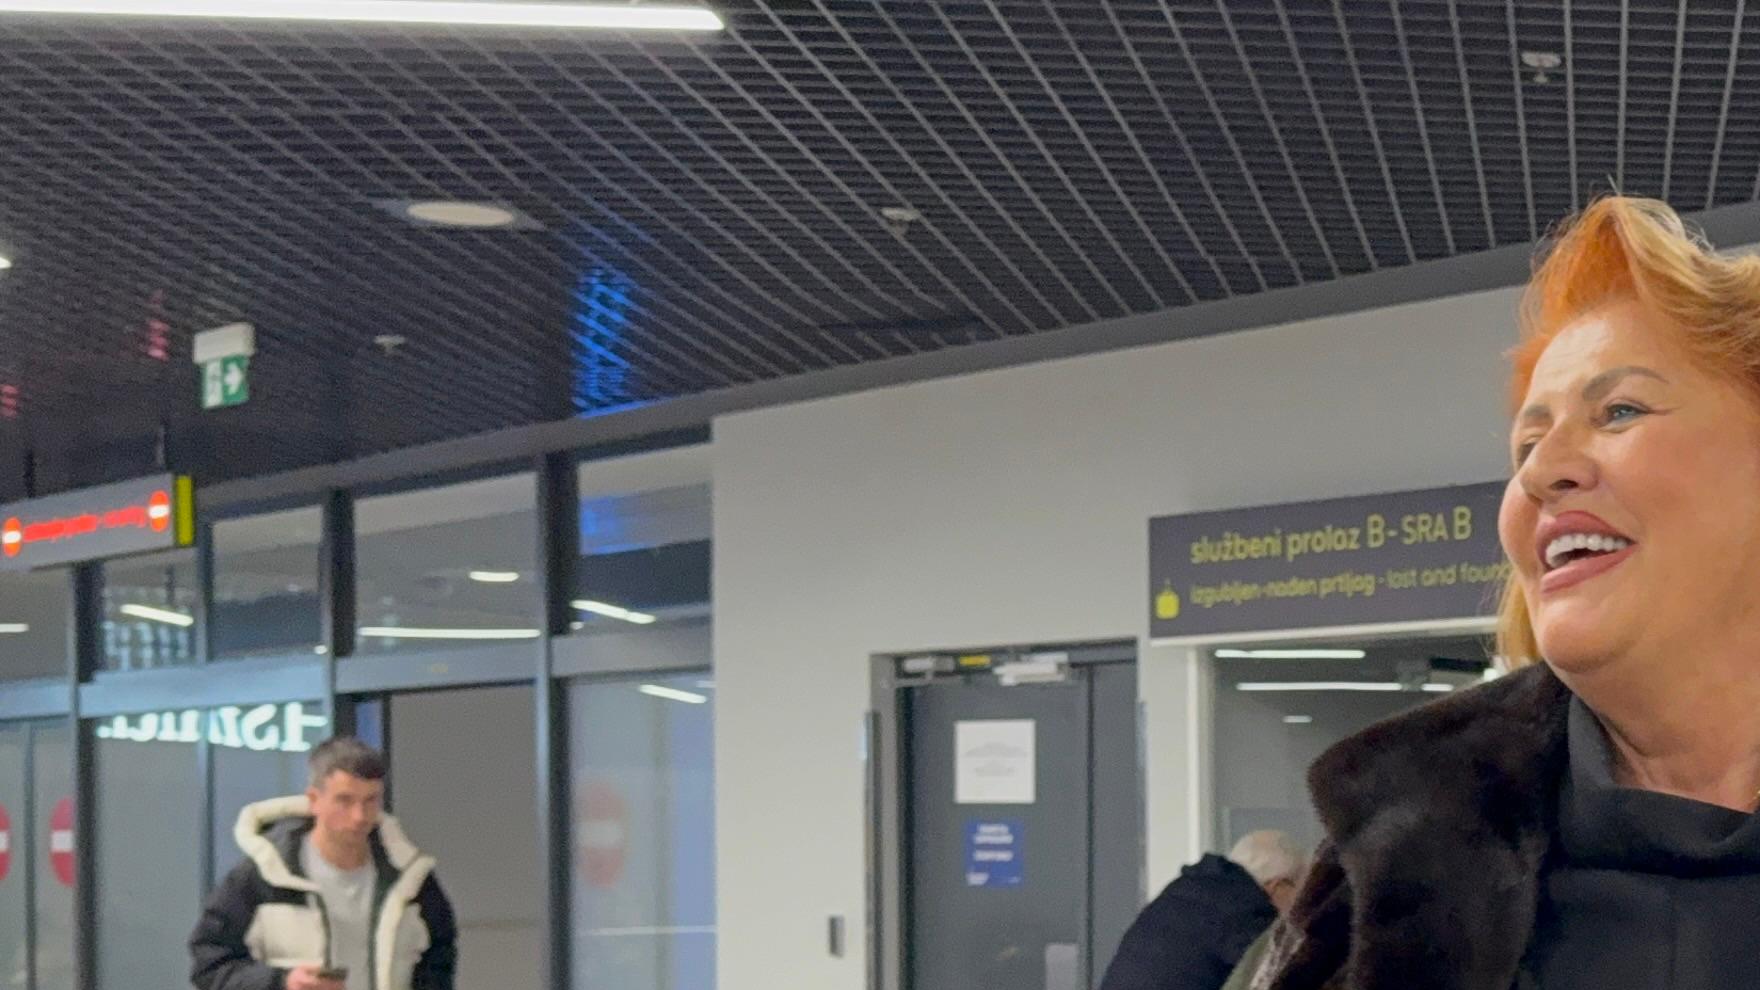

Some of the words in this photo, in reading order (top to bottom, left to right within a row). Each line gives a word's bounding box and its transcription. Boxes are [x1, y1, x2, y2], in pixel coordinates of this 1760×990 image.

[1191, 528, 1282, 564] službeni
[1287, 525, 1360, 562] prolaz
[1453, 505, 1472, 540] B
[1421, 564, 1457, 586] and
